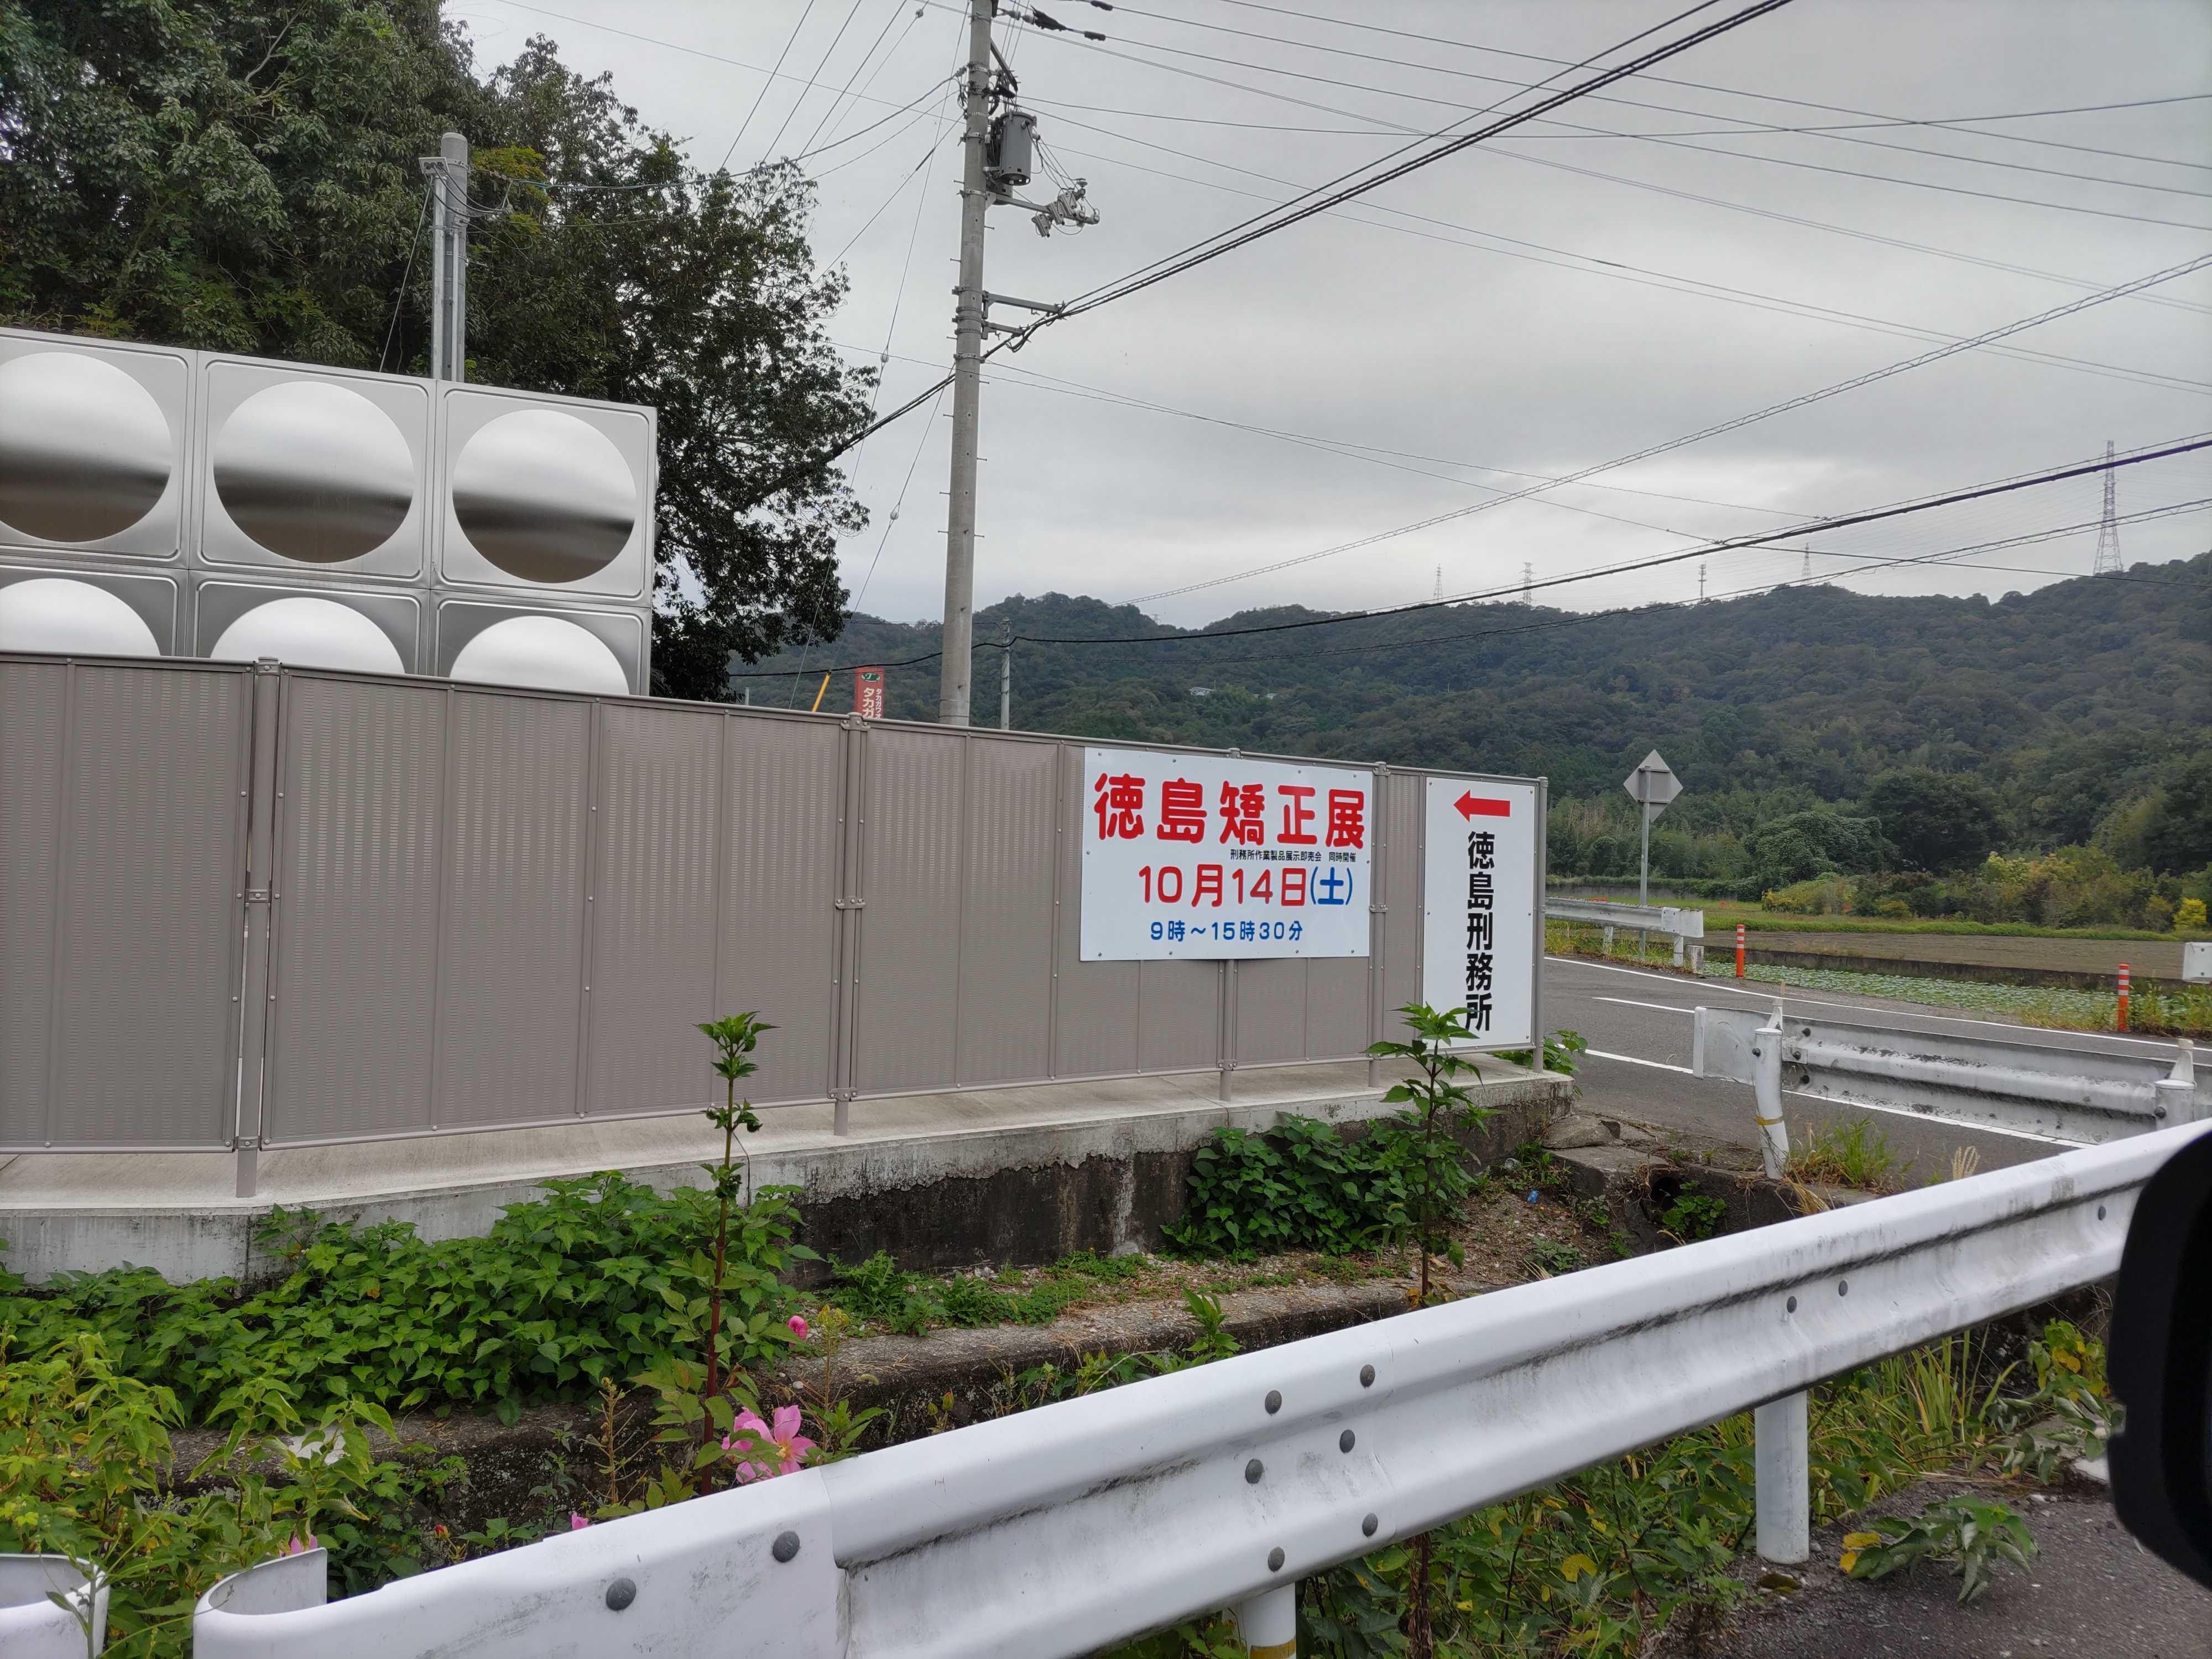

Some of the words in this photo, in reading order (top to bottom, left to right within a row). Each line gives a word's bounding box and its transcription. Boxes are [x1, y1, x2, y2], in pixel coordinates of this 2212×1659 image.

[1094, 773, 1365, 849] 徳島矯正展
[1230, 849, 1322, 862] 刑務所作業製品展示即売会
[1329, 852, 1357, 863] 同時開催
[1465, 831, 1495, 1032] 徳島刑務所
